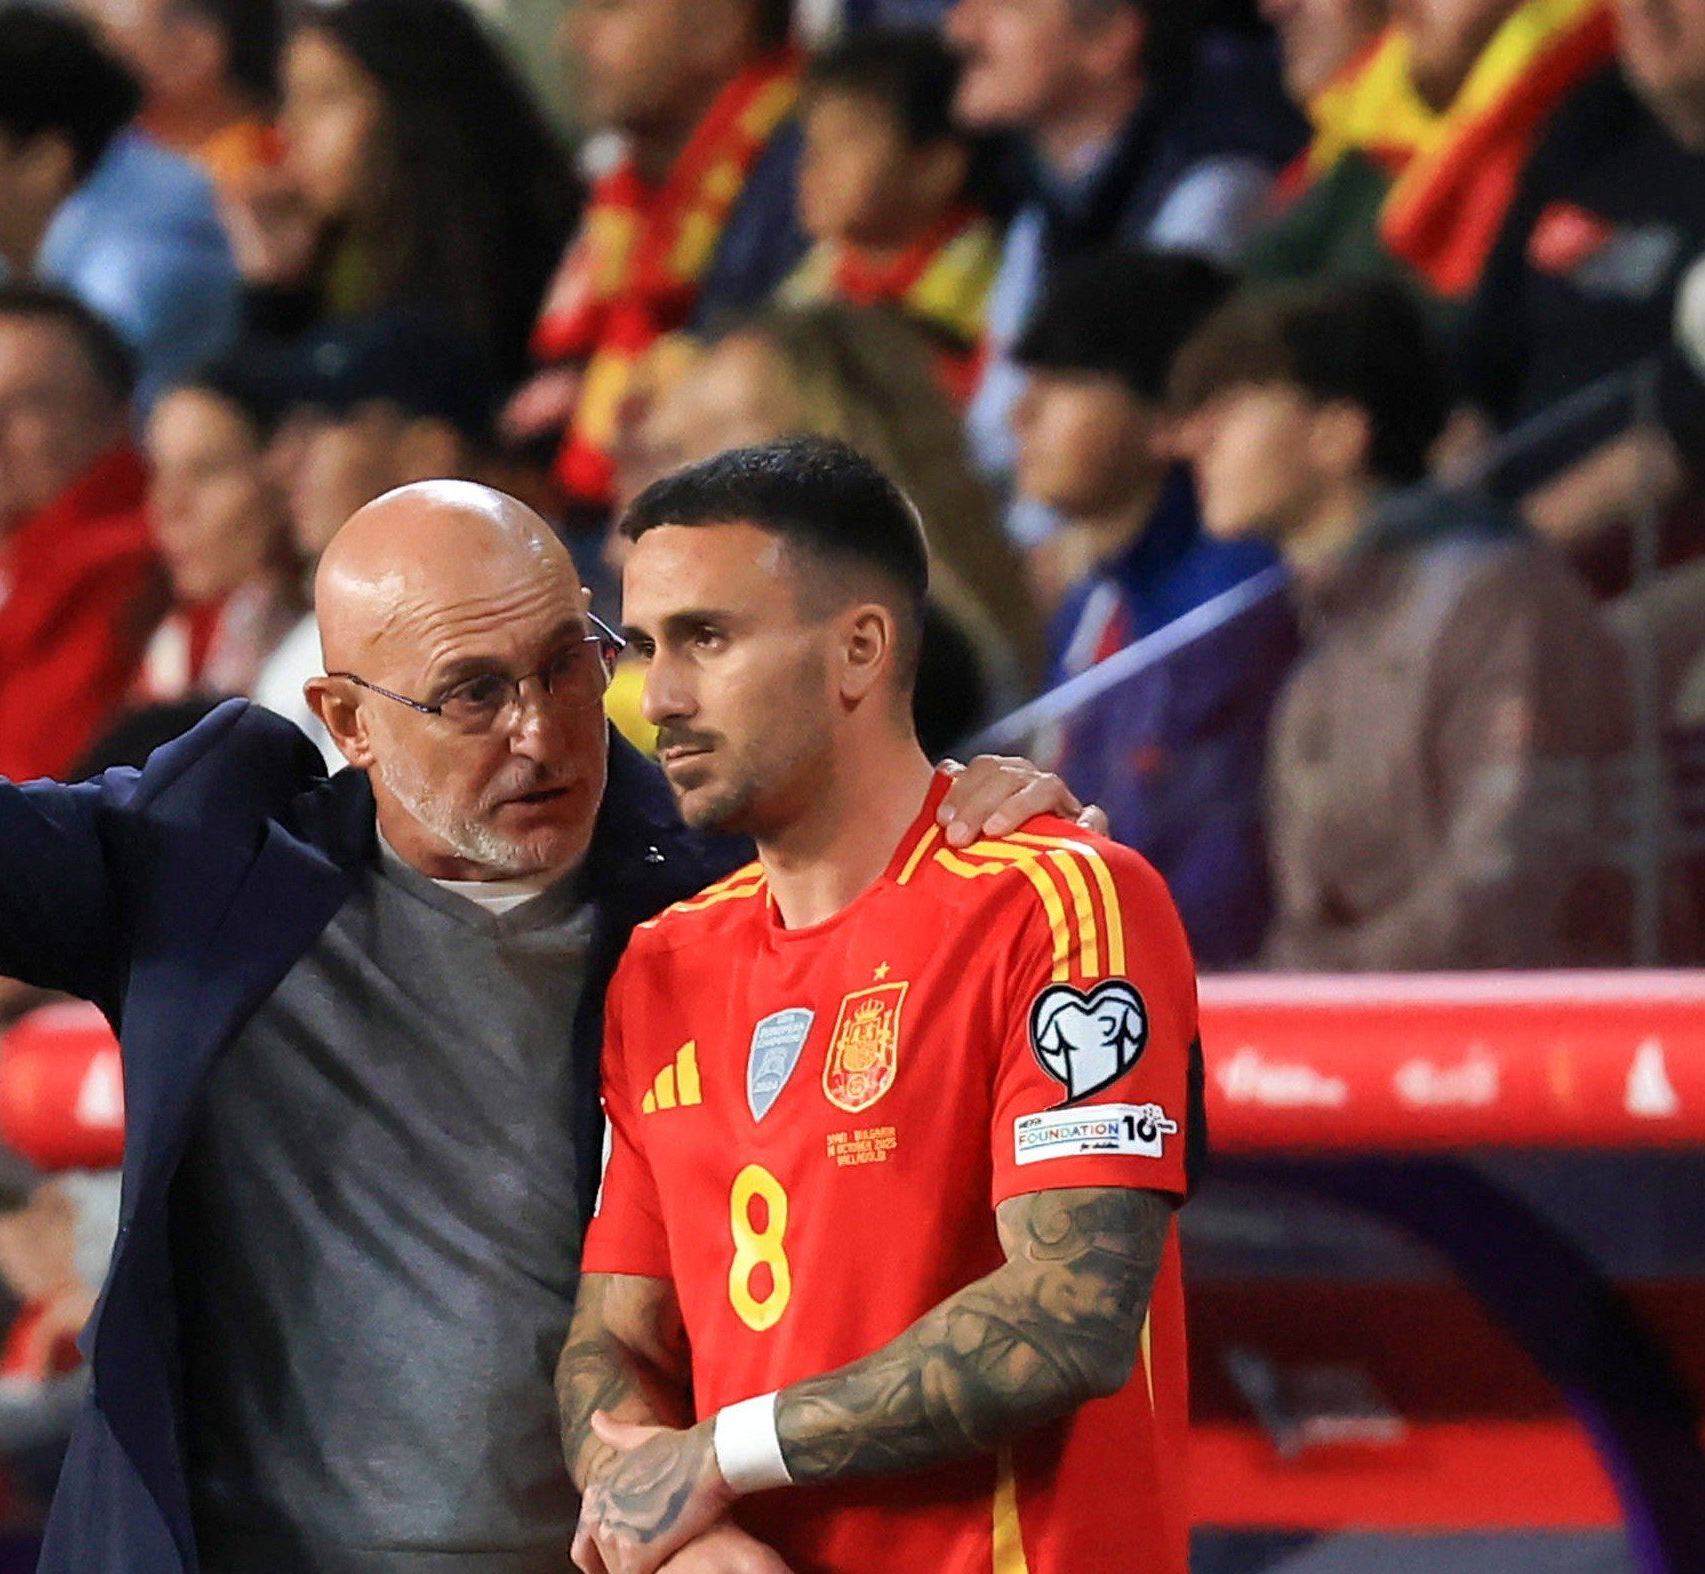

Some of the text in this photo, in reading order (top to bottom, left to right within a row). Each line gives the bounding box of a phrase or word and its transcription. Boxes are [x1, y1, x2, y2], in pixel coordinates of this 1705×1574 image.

[1018, 1113, 1158, 1147] FOUNDATION 10
[728, 1163, 791, 1332] 8
